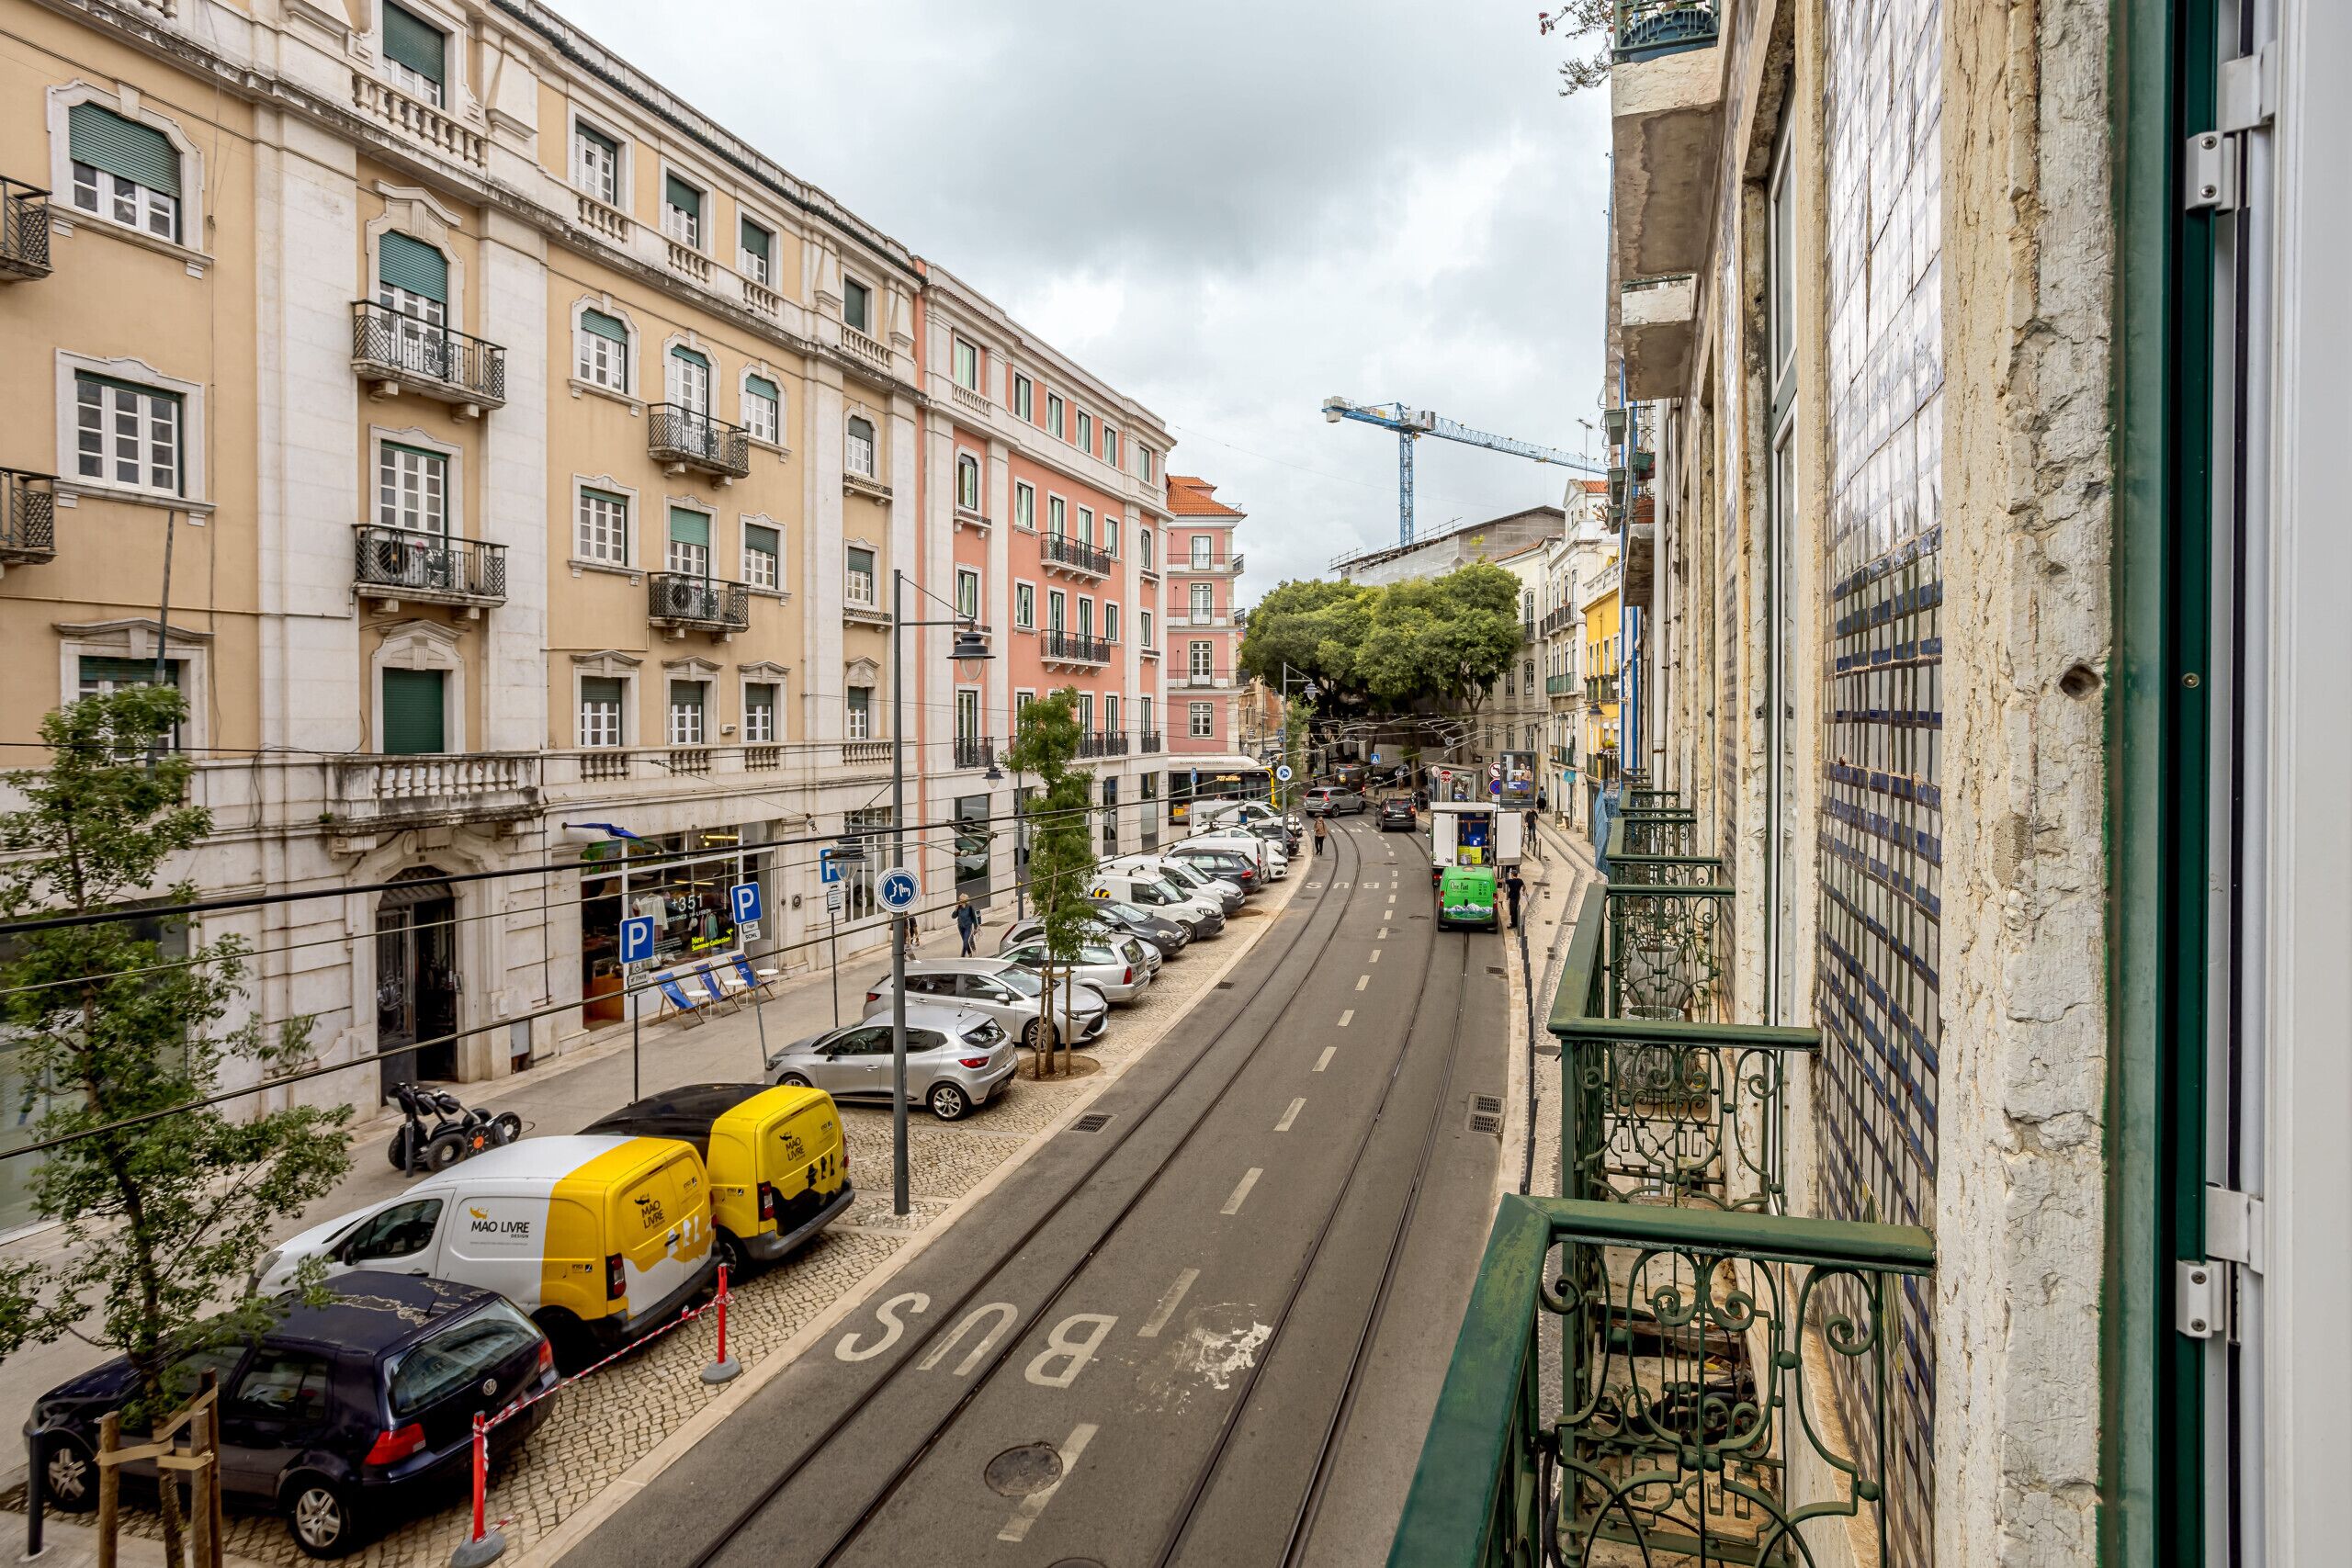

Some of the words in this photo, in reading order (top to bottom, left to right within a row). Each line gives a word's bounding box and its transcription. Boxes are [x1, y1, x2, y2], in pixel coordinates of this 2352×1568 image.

[671, 893, 702, 912] +351
[738, 888, 754, 919] P
[628, 922, 647, 959] P
[691, 943, 709, 951] Summer
[710, 936, 731, 946] Collection
[787, 1145, 805, 1162] LIVRE
[501, 1221, 530, 1233] LIVRE
[644, 1209, 664, 1229] LIVRE
[835, 1292, 1119, 1388] BUS
